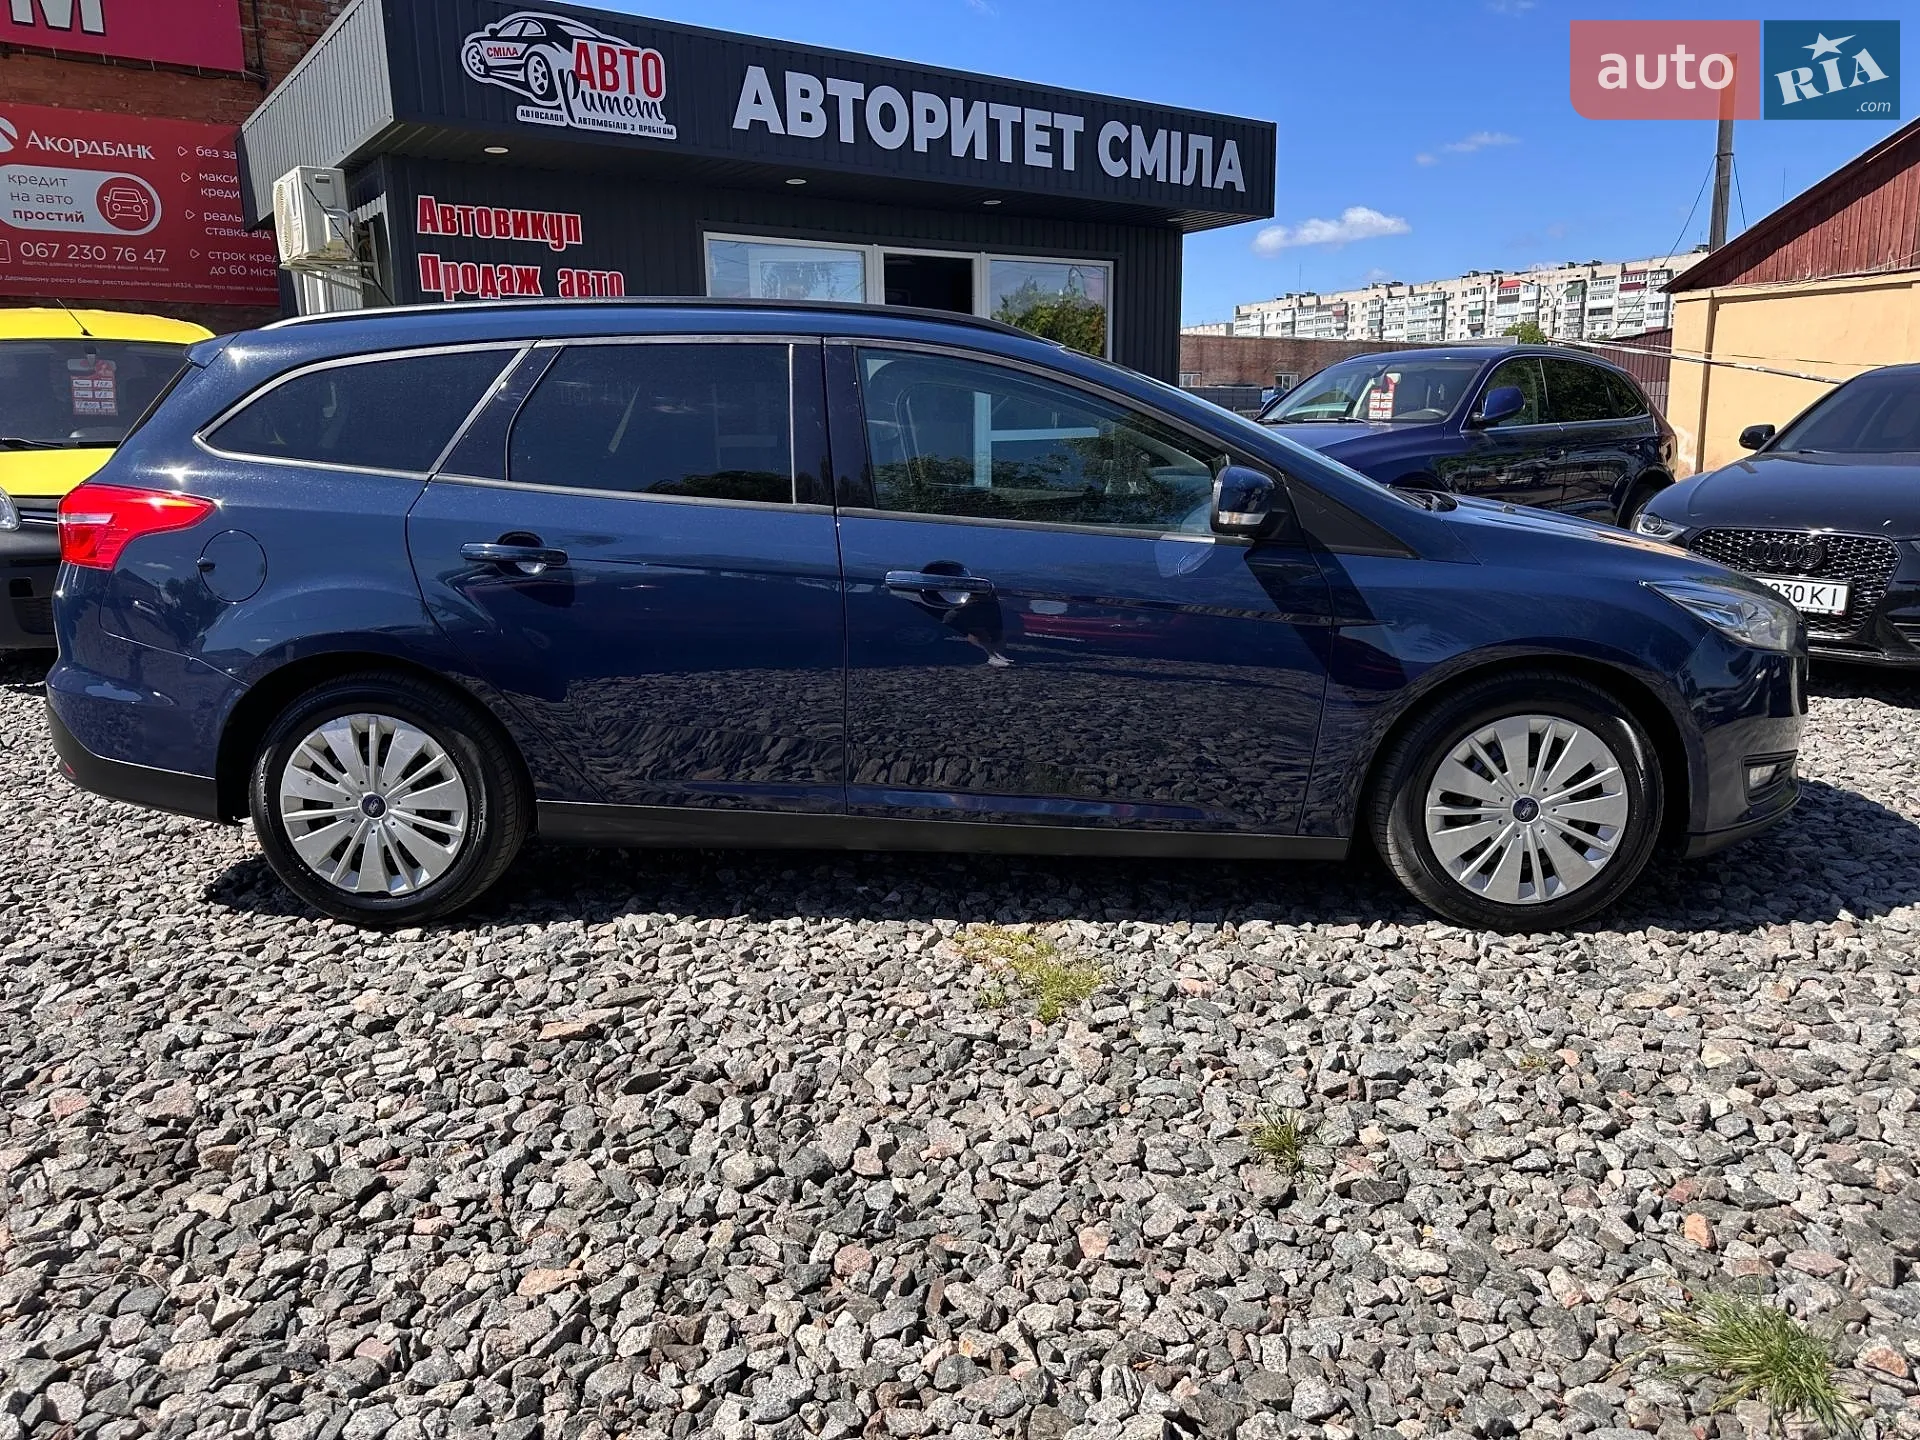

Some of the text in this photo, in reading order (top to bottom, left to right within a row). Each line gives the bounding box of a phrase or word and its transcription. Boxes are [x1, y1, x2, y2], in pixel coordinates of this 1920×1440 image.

[573, 41, 664, 99] АВТО
[732, 65, 1246, 193] АВТОРИТЕТ СМІЛА
[195, 145, 220, 158] без
[8, 173, 68, 188] кредит
[10, 192, 74, 206] на авто
[12, 209, 85, 223] простий
[417, 194, 583, 252] Автовикуп
[20, 241, 167, 265] 067 230 76 47
[208, 250, 246, 262] строк
[210, 265, 226, 277] до
[229, 264, 247, 276] 60
[418, 253, 626, 302] Продаж авто
